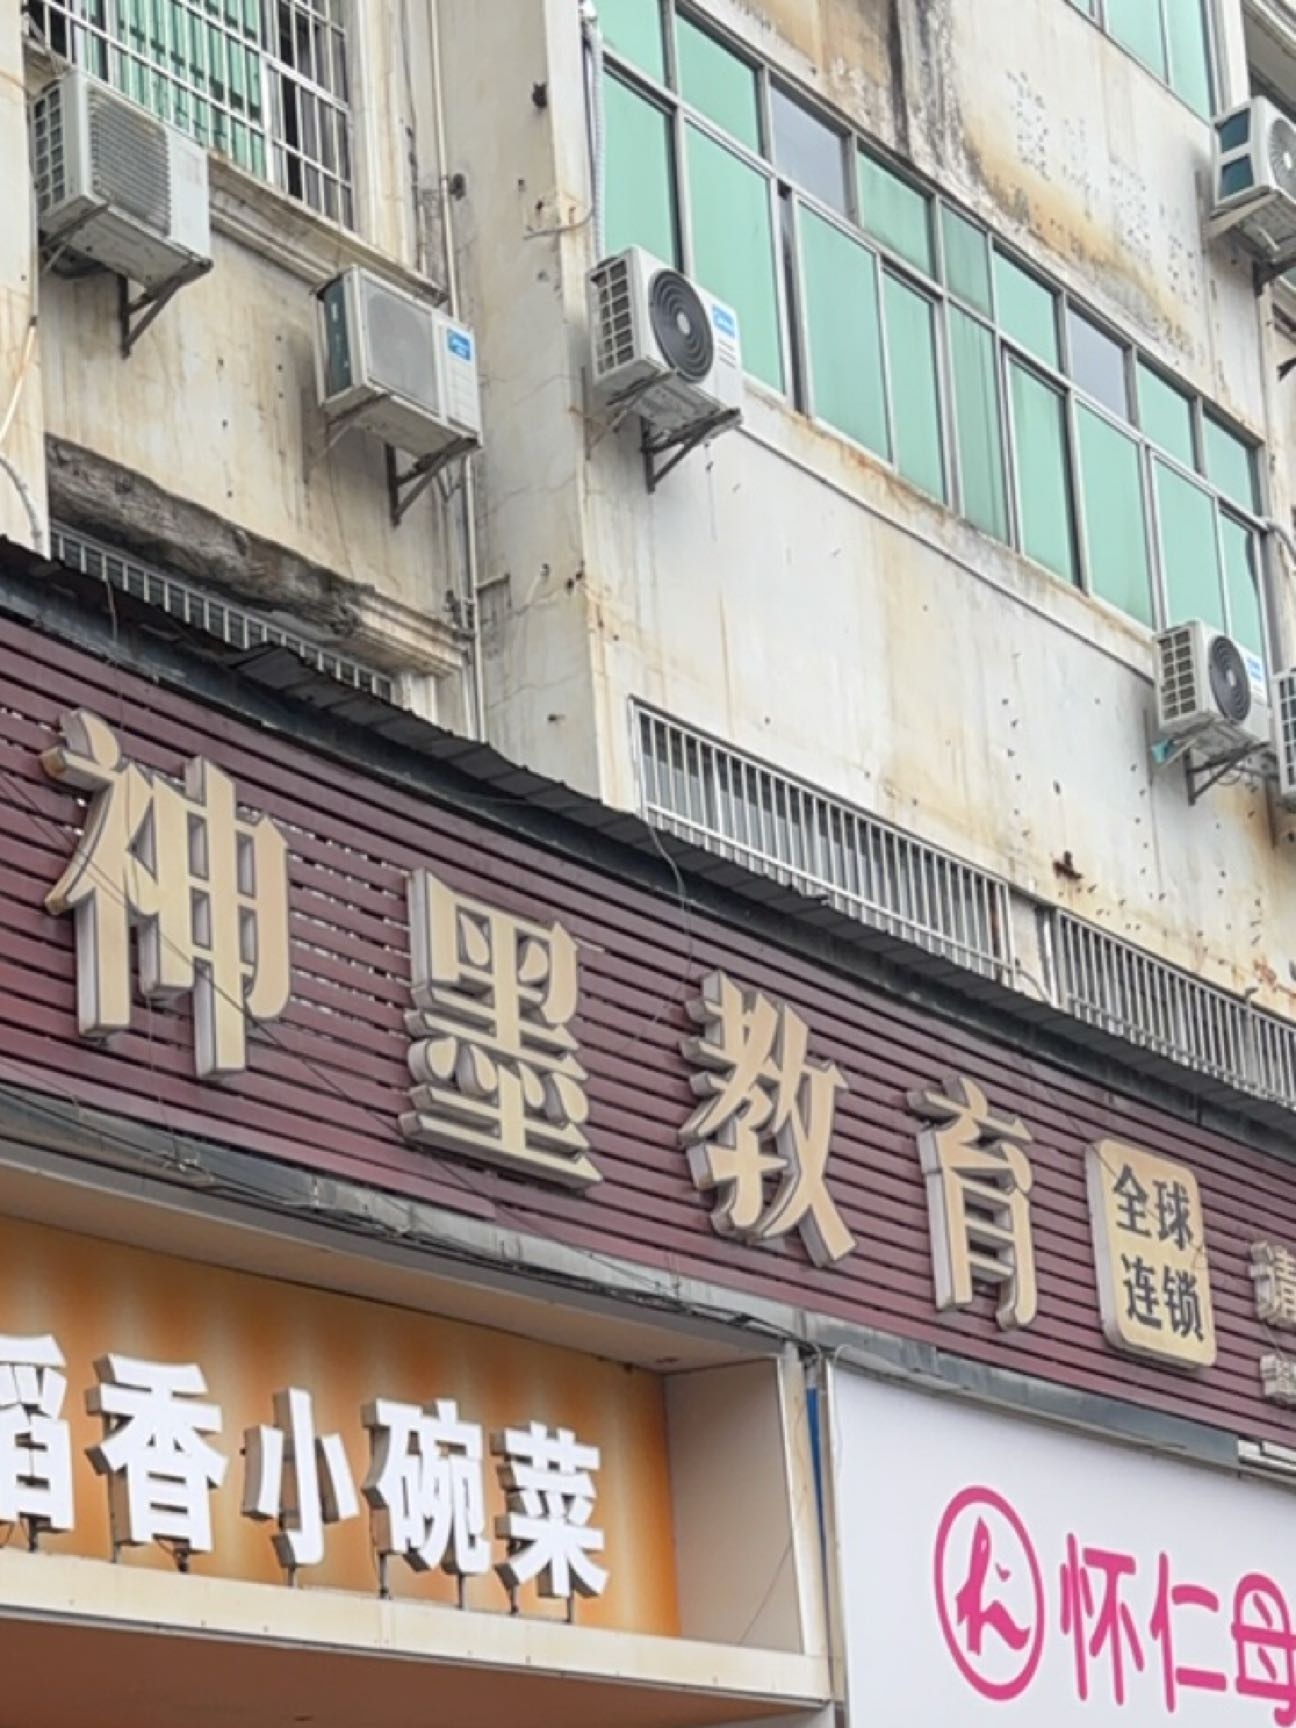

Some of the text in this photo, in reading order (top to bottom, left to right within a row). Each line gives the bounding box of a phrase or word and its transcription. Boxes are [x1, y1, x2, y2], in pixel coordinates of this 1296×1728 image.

[41, 708, 1039, 1331] 神墨教育
[1112, 1163, 1195, 1251] 全球
[1119, 1252, 1206, 1343] 连锁
[1059, 1531, 1296, 1728] 怀仁母
